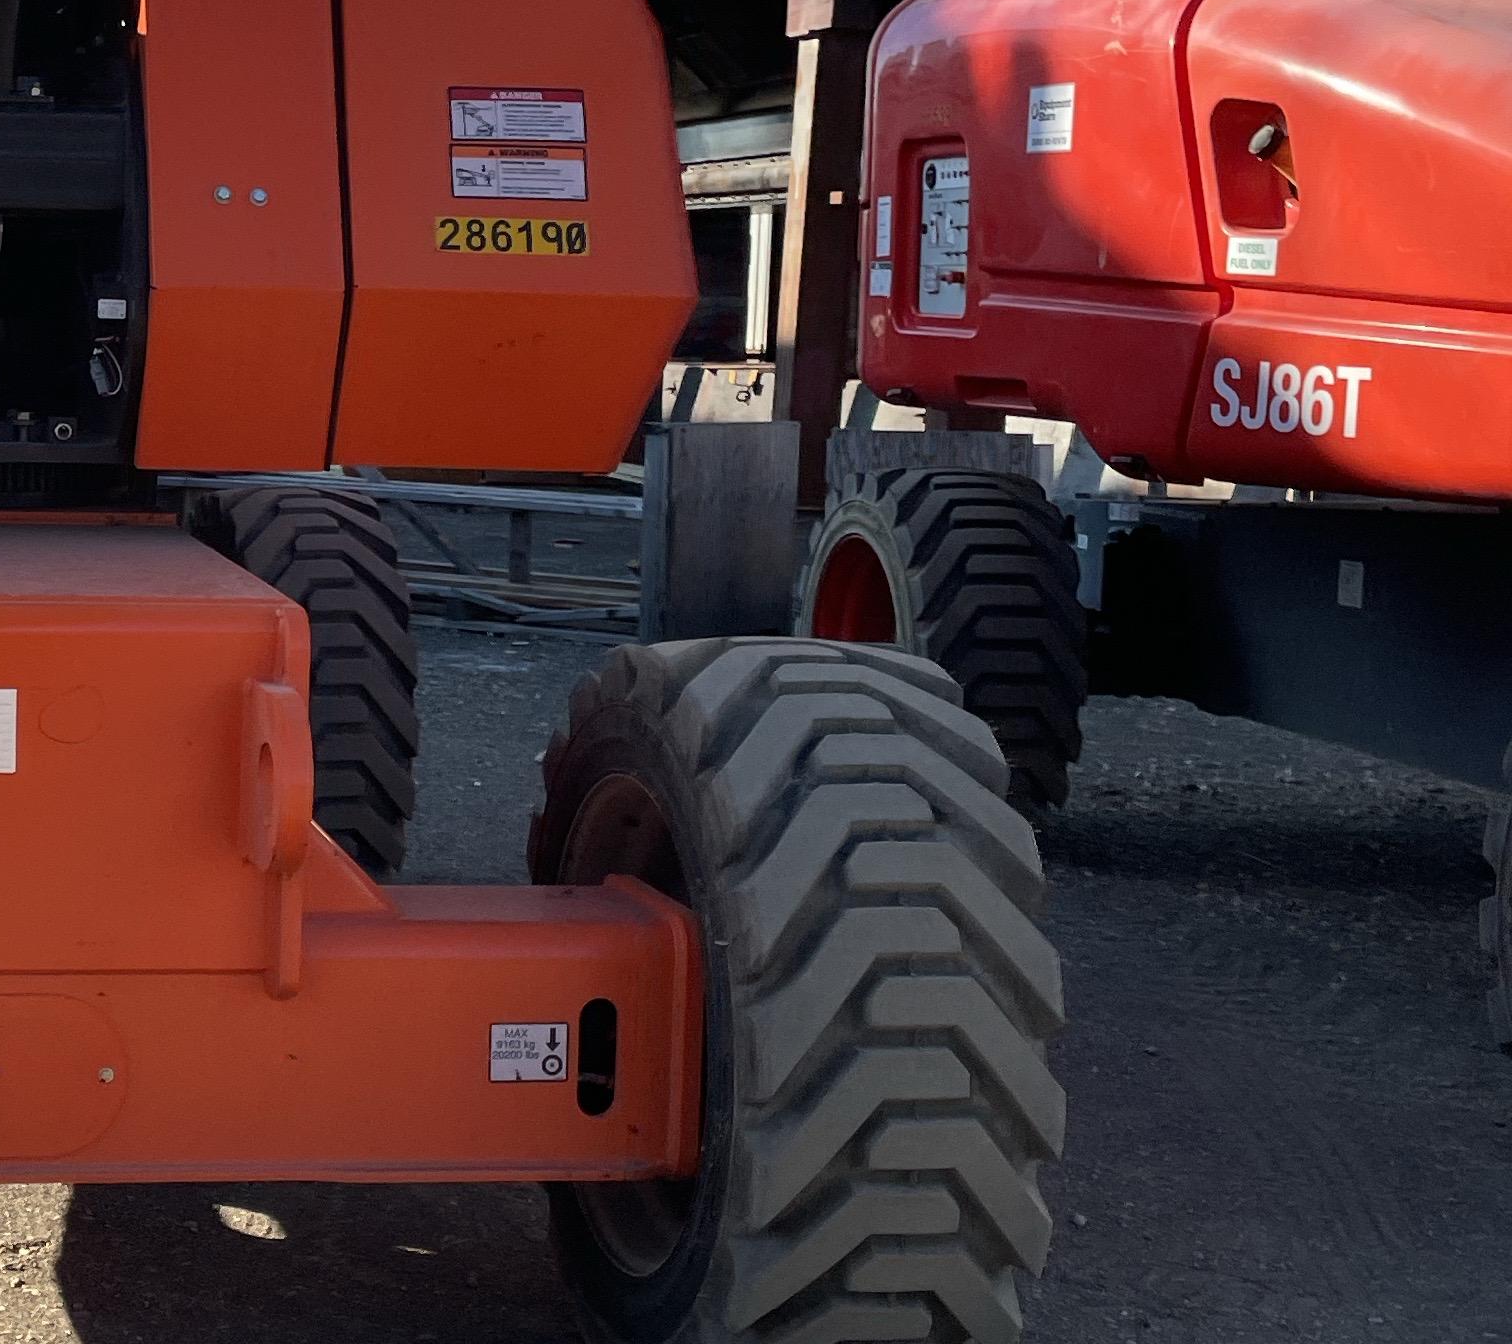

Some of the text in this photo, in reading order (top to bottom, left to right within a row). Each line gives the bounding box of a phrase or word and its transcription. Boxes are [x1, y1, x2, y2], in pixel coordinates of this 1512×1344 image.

[438, 218, 587, 254] 286190
[1238, 243, 1265, 254] DIESEL
[1230, 258, 1273, 270] FUEL ONLY
[1210, 357, 1372, 439] SJ86T
[504, 1028, 529, 1038] MAX
[524, 1040, 536, 1051] kg
[492, 1051, 540, 1060] 20200 lbs
